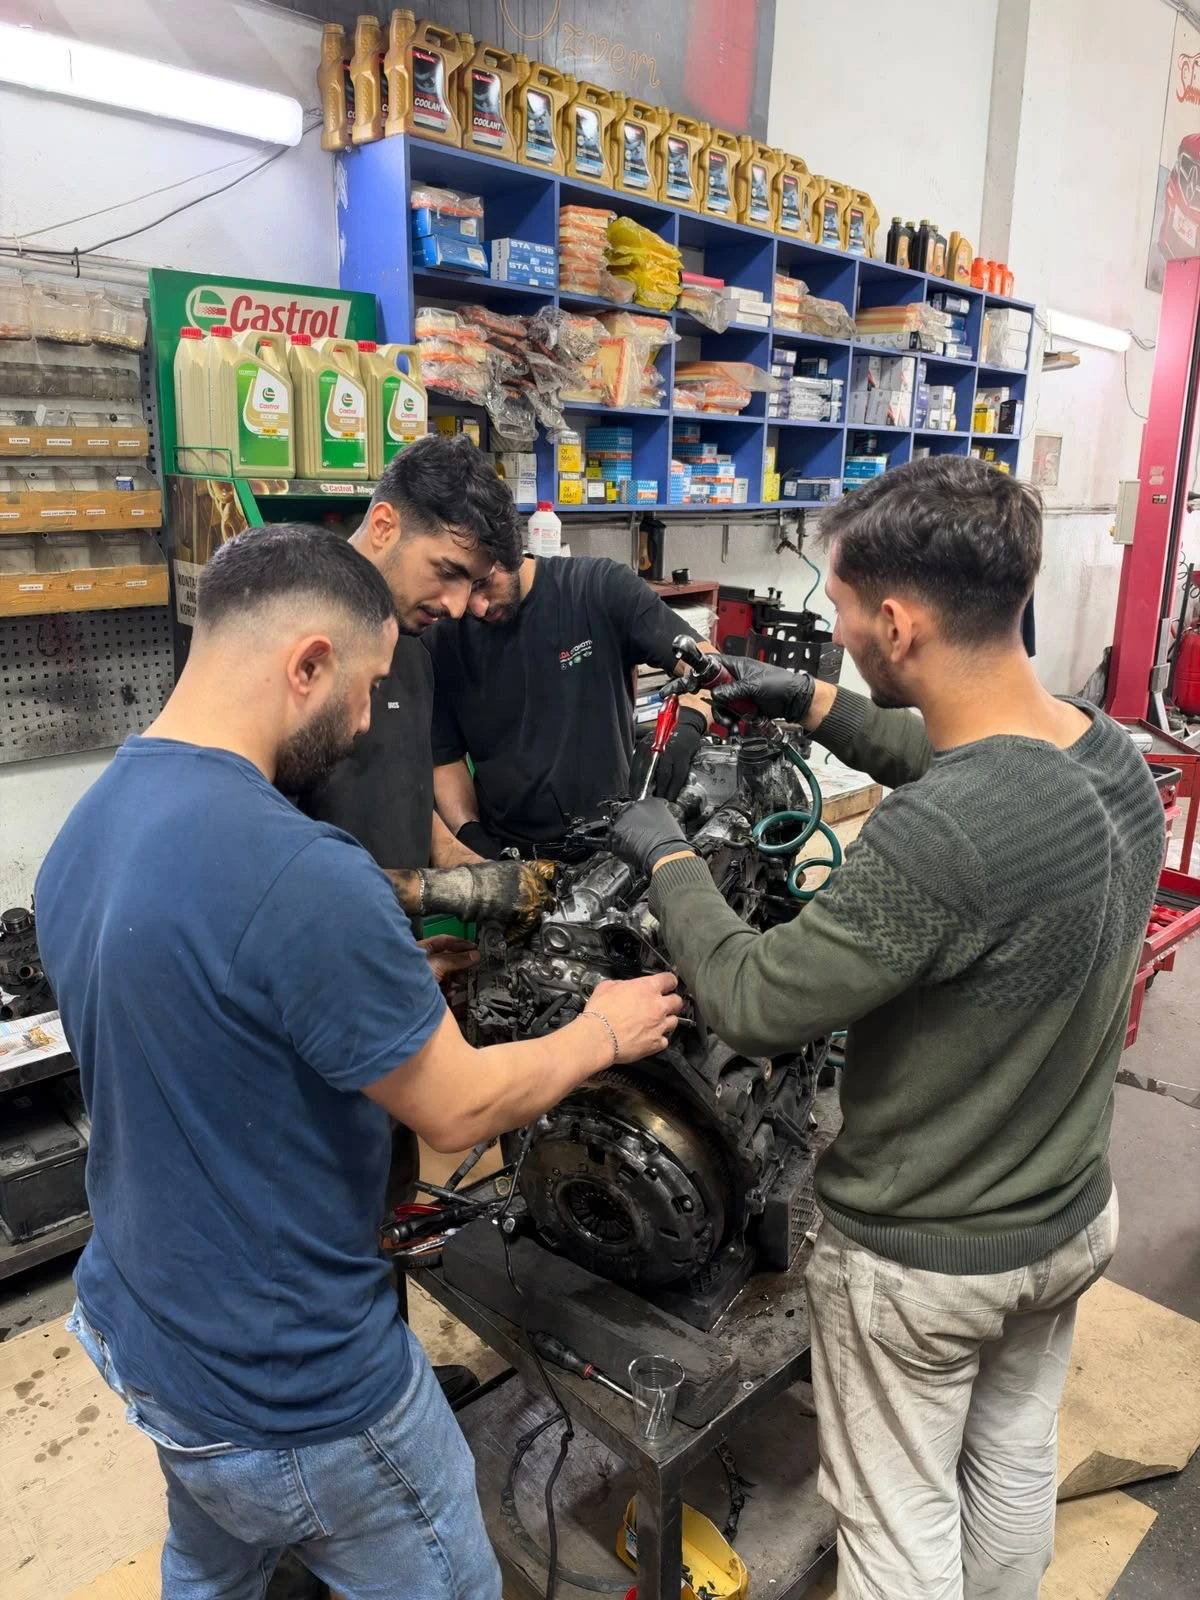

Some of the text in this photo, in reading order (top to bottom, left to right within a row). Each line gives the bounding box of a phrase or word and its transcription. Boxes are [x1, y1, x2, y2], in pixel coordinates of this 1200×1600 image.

[414, 97, 444, 113] COOLANT
[473, 116, 501, 131] COOLANT
[511, 240, 531, 250] STA
[508, 261, 530, 271] STA
[229, 295, 339, 339] Castrol
[259, 402, 280, 410] Castrol
